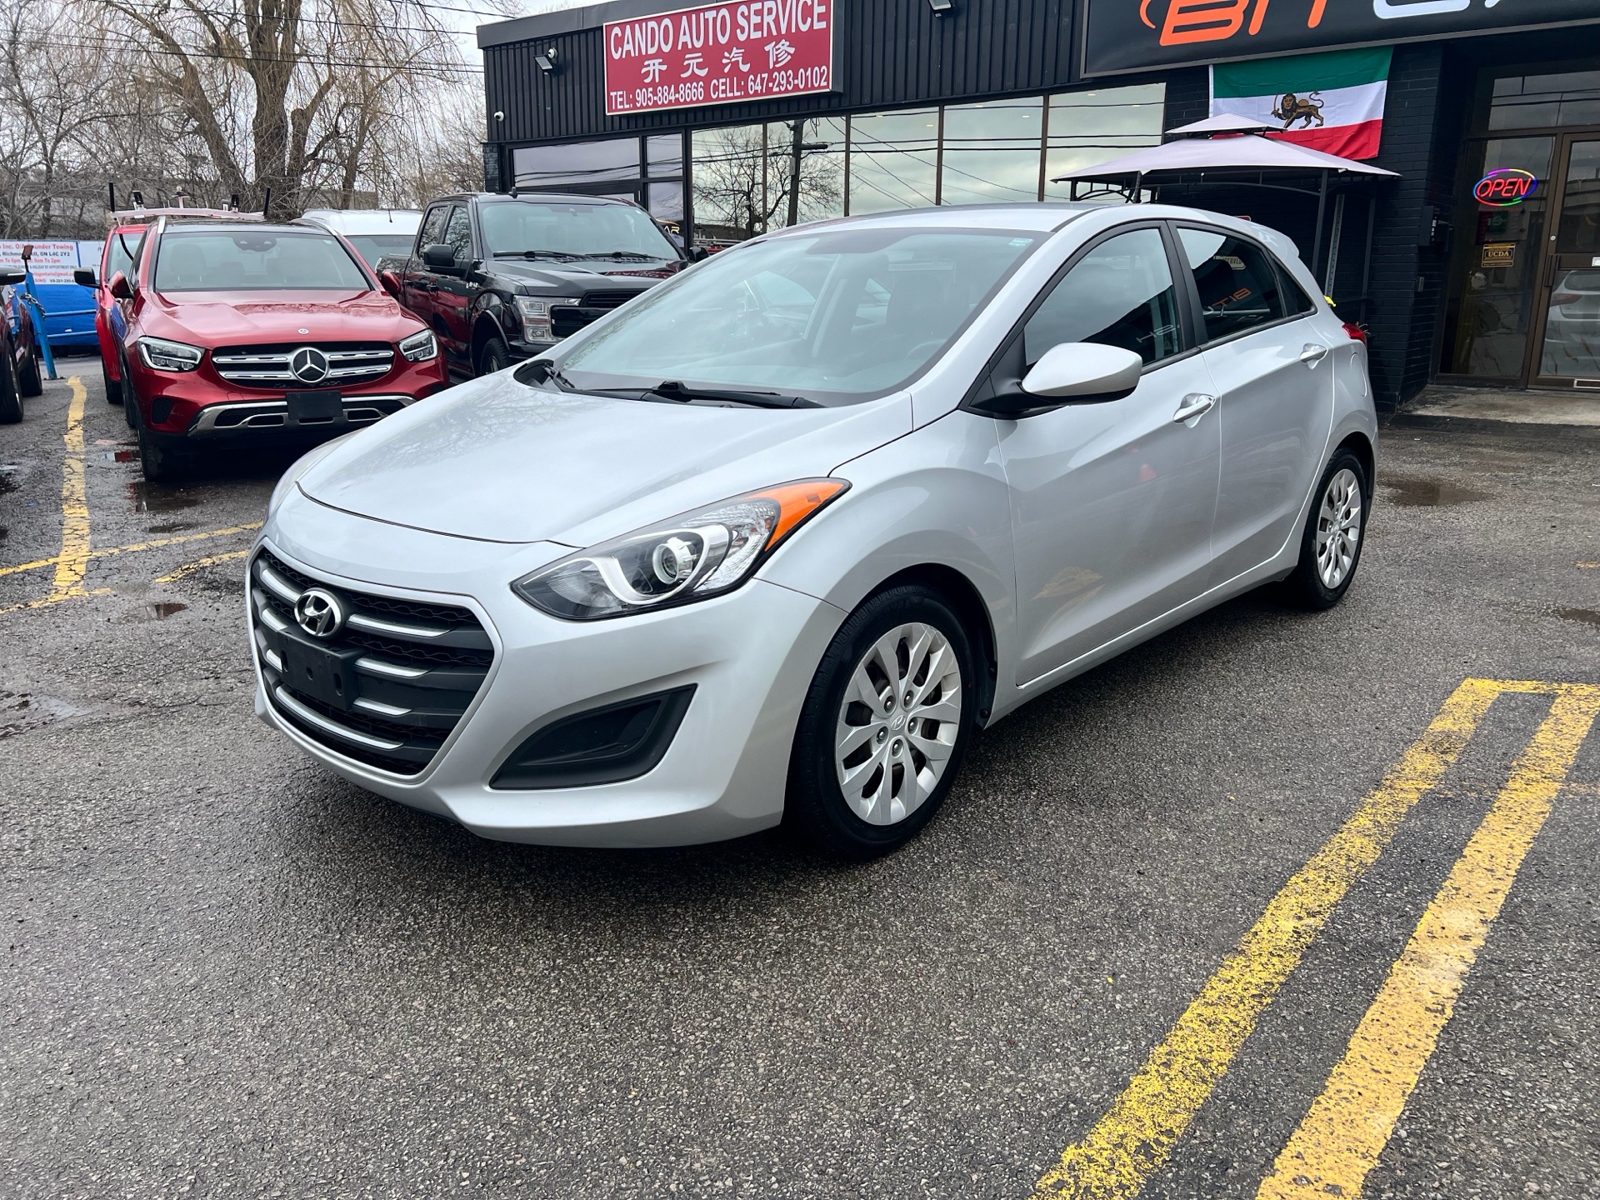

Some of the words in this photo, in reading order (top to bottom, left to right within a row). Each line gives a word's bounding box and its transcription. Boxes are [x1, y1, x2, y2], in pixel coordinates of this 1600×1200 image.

[610, 18, 674, 59] CANDO
[677, 8, 731, 51] AUTO
[736, 0, 827, 42] SERVICE
[640, 38, 796, 84] 开元汽修
[610, 90, 633, 110] TEL:
[635, 81, 704, 108] 905-884-8666
[710, 76, 745, 99] CELL:
[748, 65, 828, 95] 647-293-0102
[1477, 177, 1532, 197] OPEN
[52, 243, 74, 251] Towing
